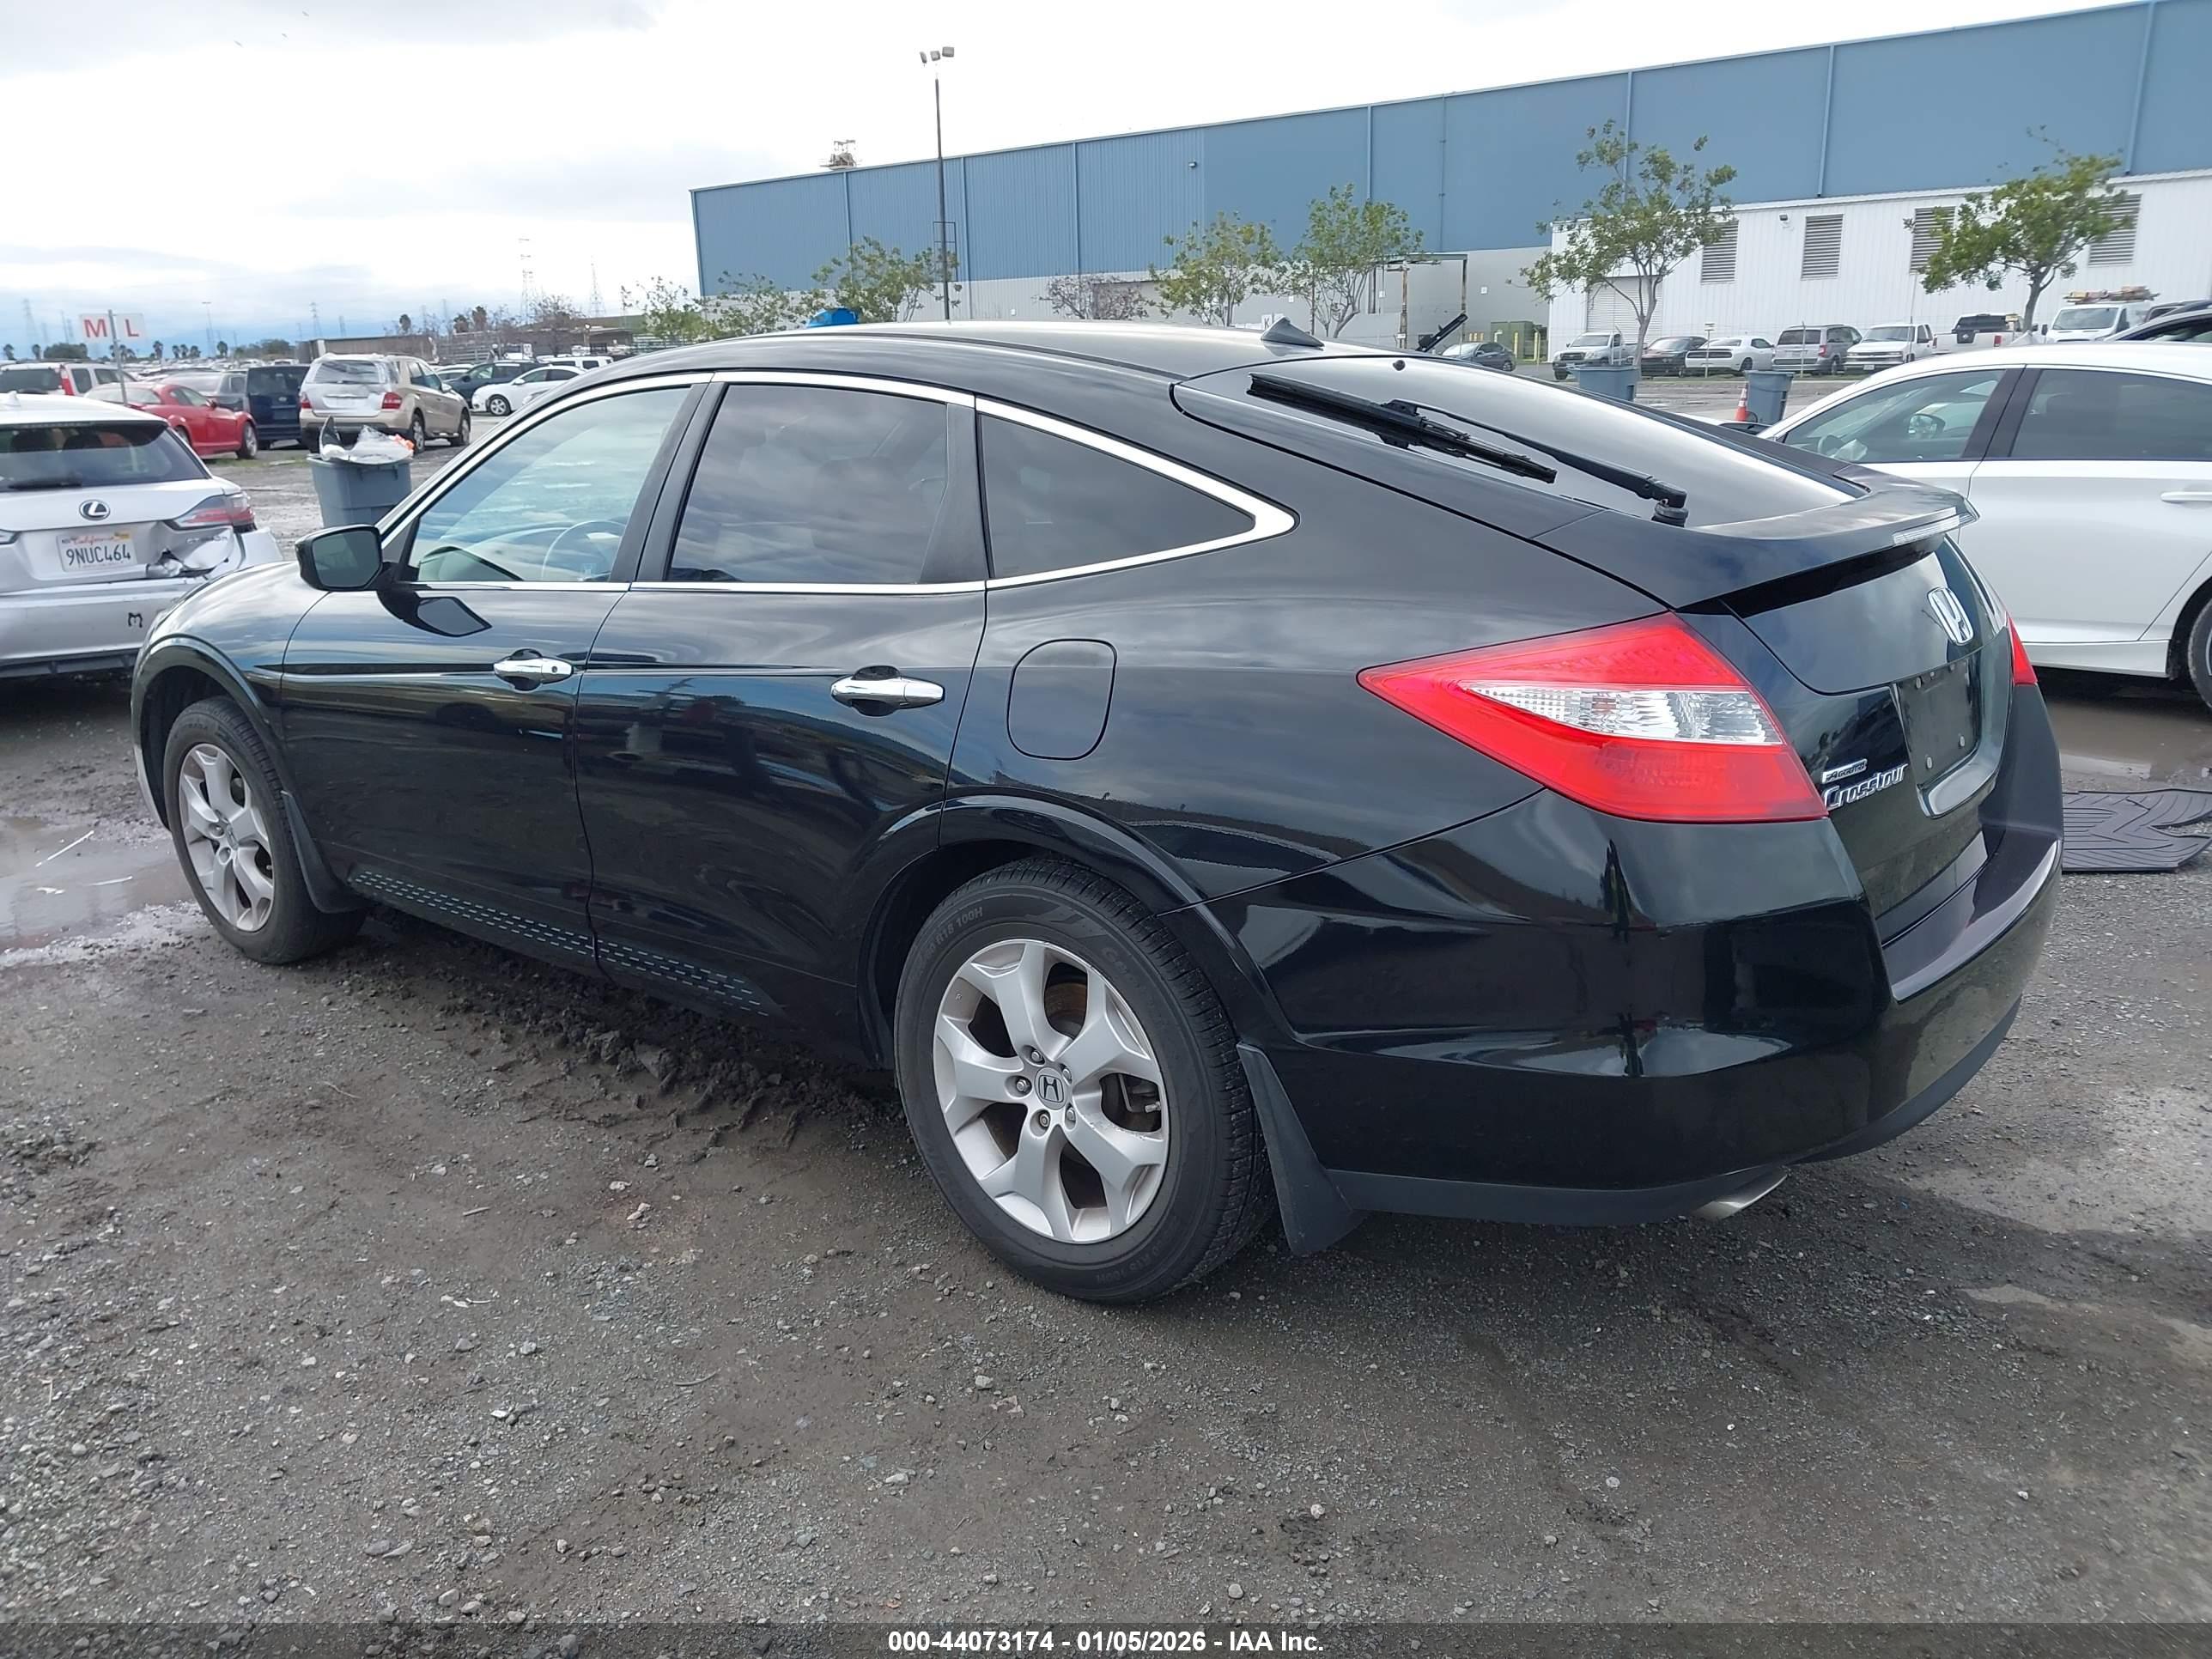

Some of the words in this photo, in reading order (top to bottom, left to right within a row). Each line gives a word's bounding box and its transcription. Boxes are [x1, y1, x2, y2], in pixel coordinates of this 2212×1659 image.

[83, 319, 107, 337] M
[125, 319, 139, 337] L
[66, 544, 131, 566] 9NUC464
[1822, 763, 1909, 811] Crosstour
[956, 907, 983, 927] 100H
